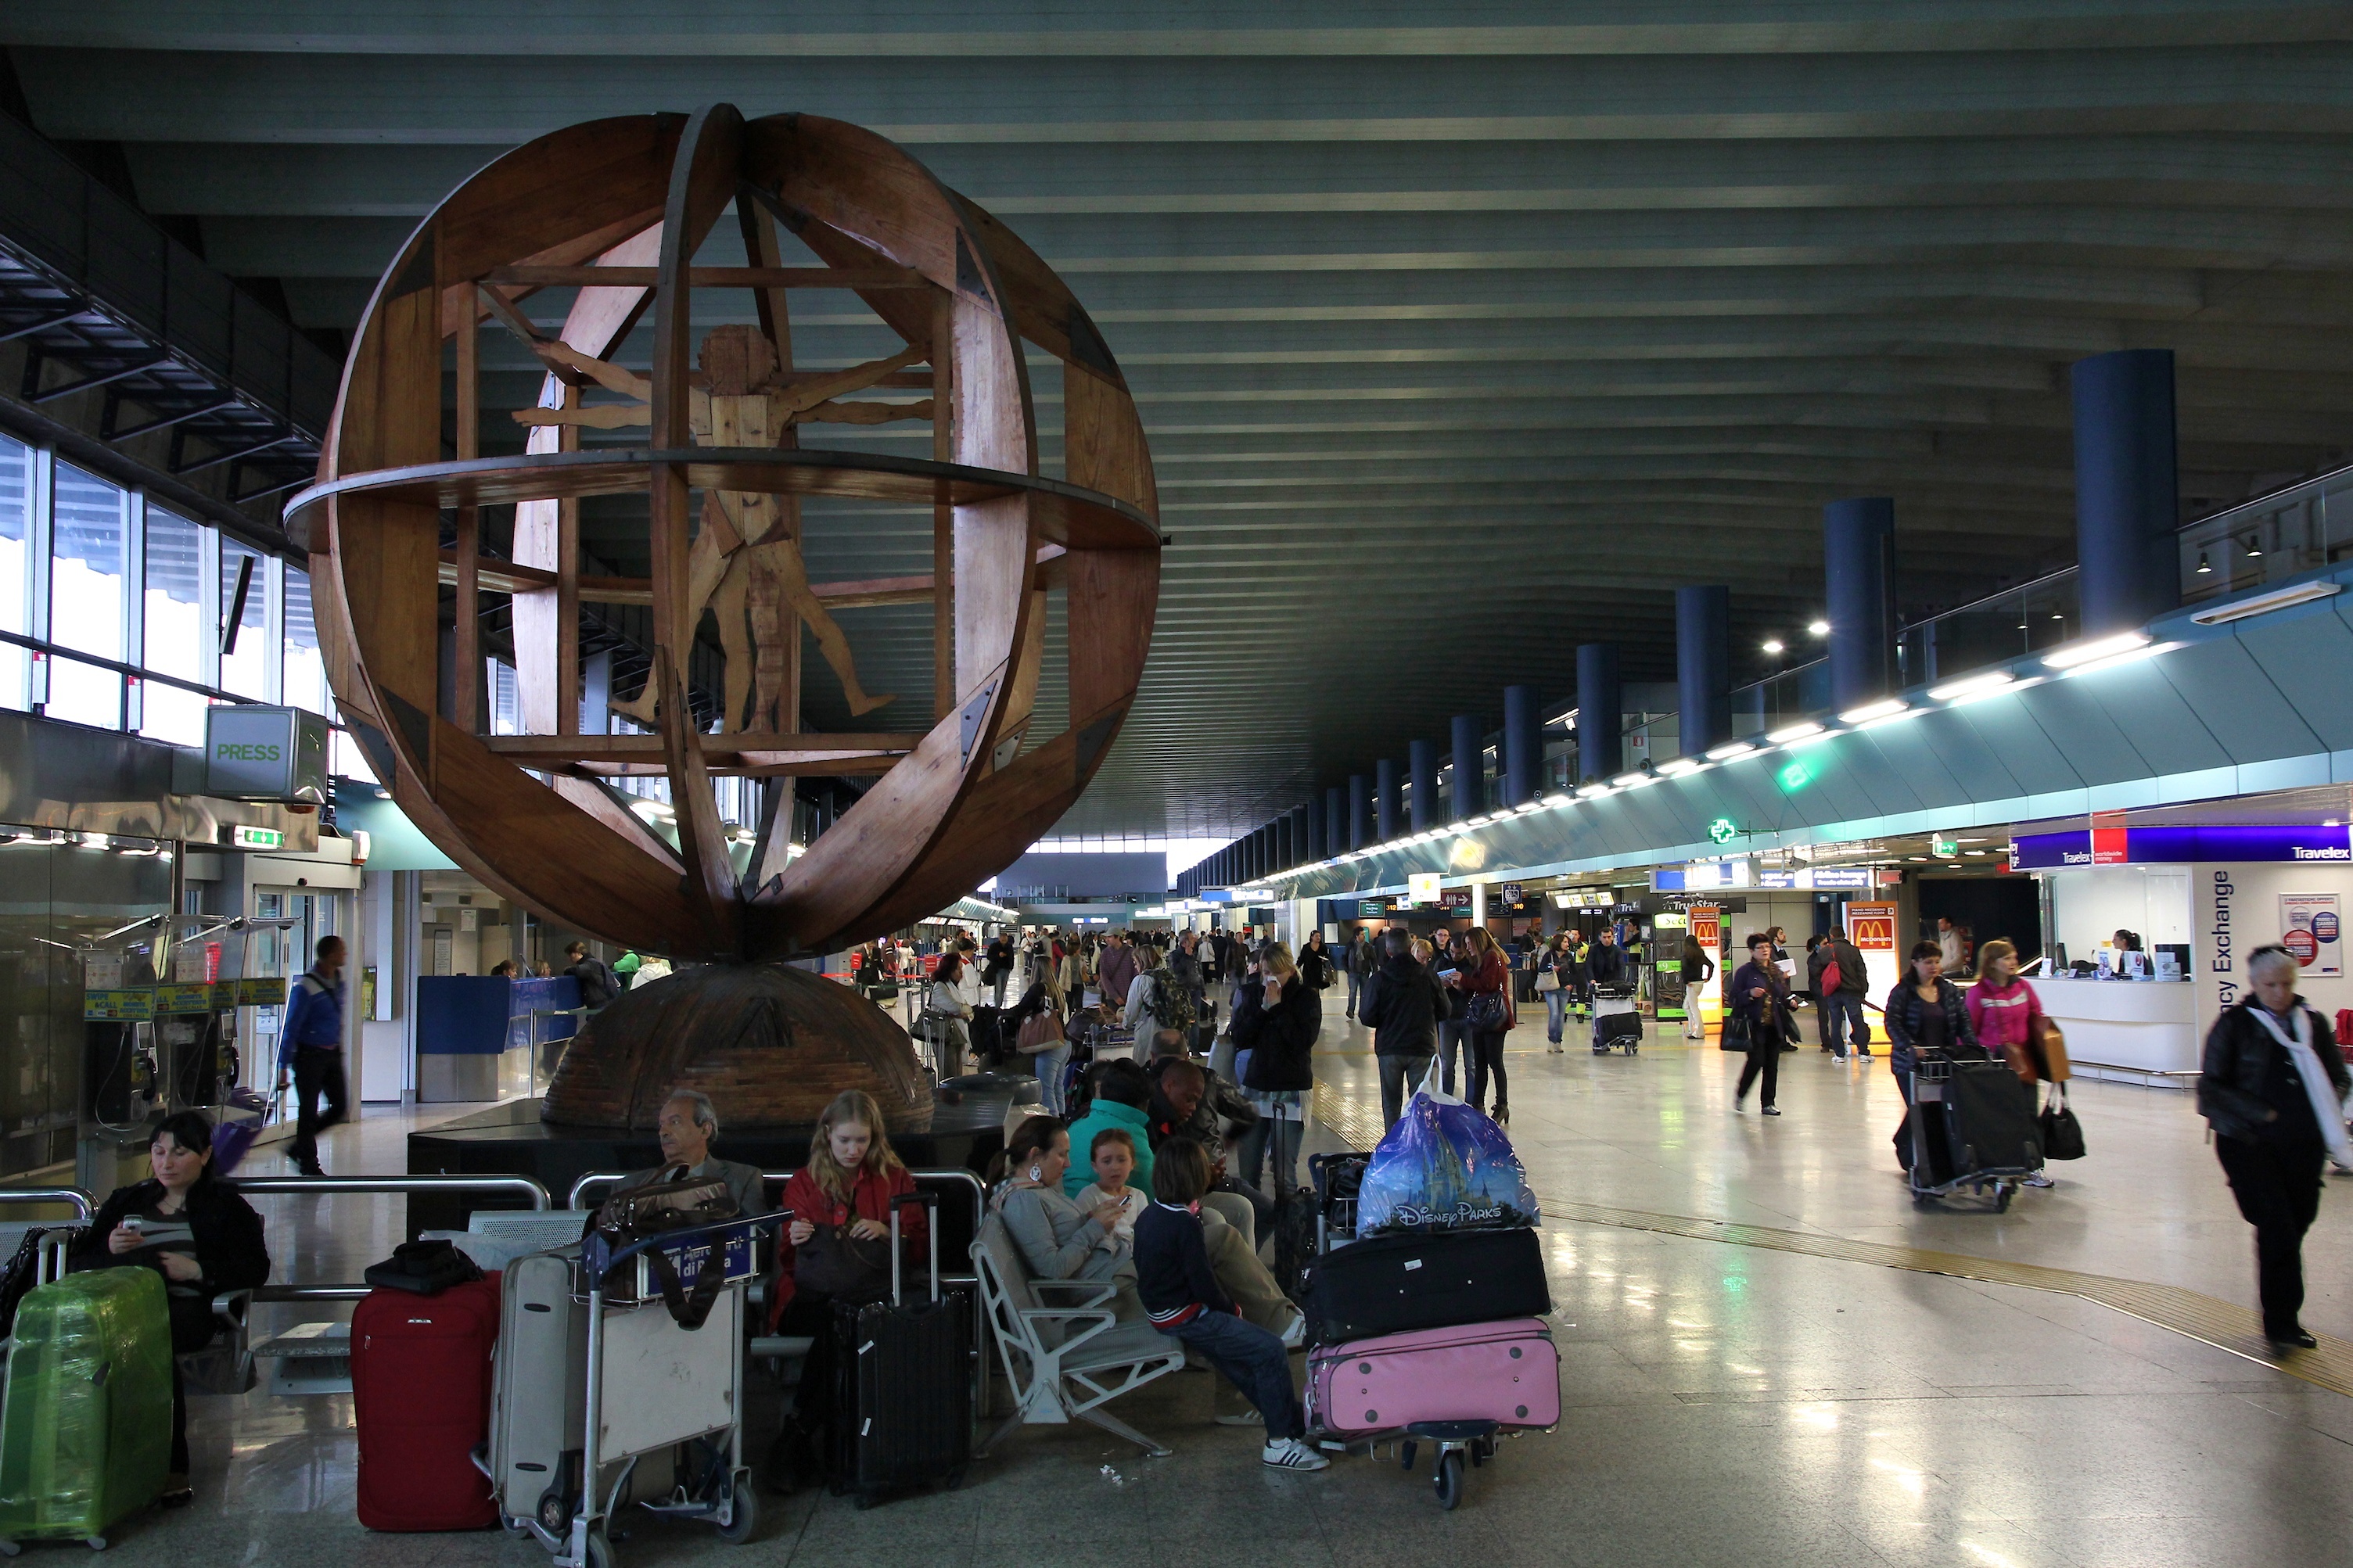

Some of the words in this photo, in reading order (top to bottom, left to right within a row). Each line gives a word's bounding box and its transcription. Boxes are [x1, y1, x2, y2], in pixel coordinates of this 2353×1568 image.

[217, 744, 280, 761] PRESS
[2063, 851, 2091, 863] Travelex
[2291, 846, 2350, 859] Travelex
[1672, 899, 1719, 910] TrueStar
[2211, 870, 2234, 972] Exchange
[683, 1261, 695, 1277] di
[698, 1257, 731, 1274] Ra
